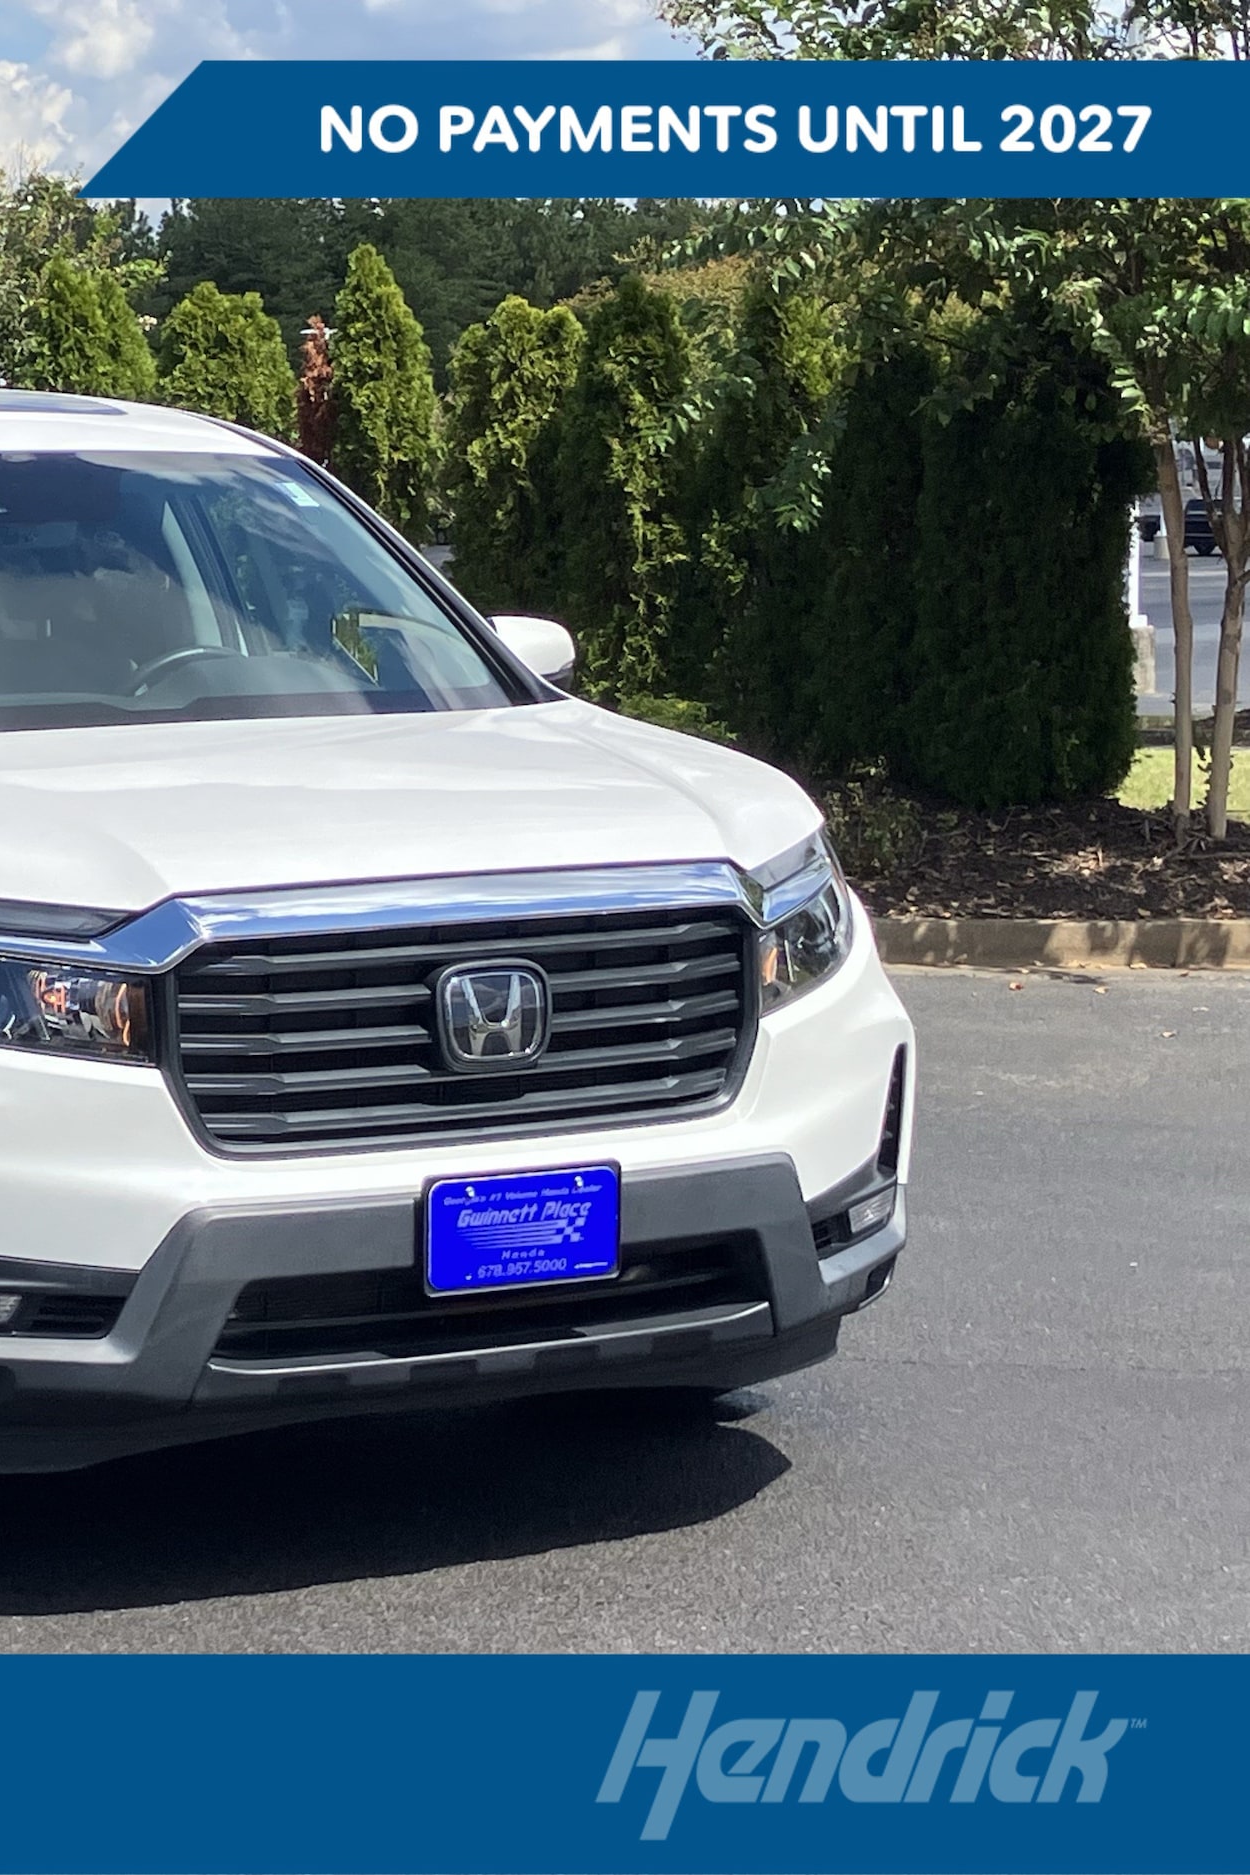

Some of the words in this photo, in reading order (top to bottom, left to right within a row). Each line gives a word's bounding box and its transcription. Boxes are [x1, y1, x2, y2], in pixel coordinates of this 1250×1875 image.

[456, 1202, 538, 1228] Gwinnett
[541, 1200, 592, 1221] Place
[501, 1247, 546, 1260] Honda
